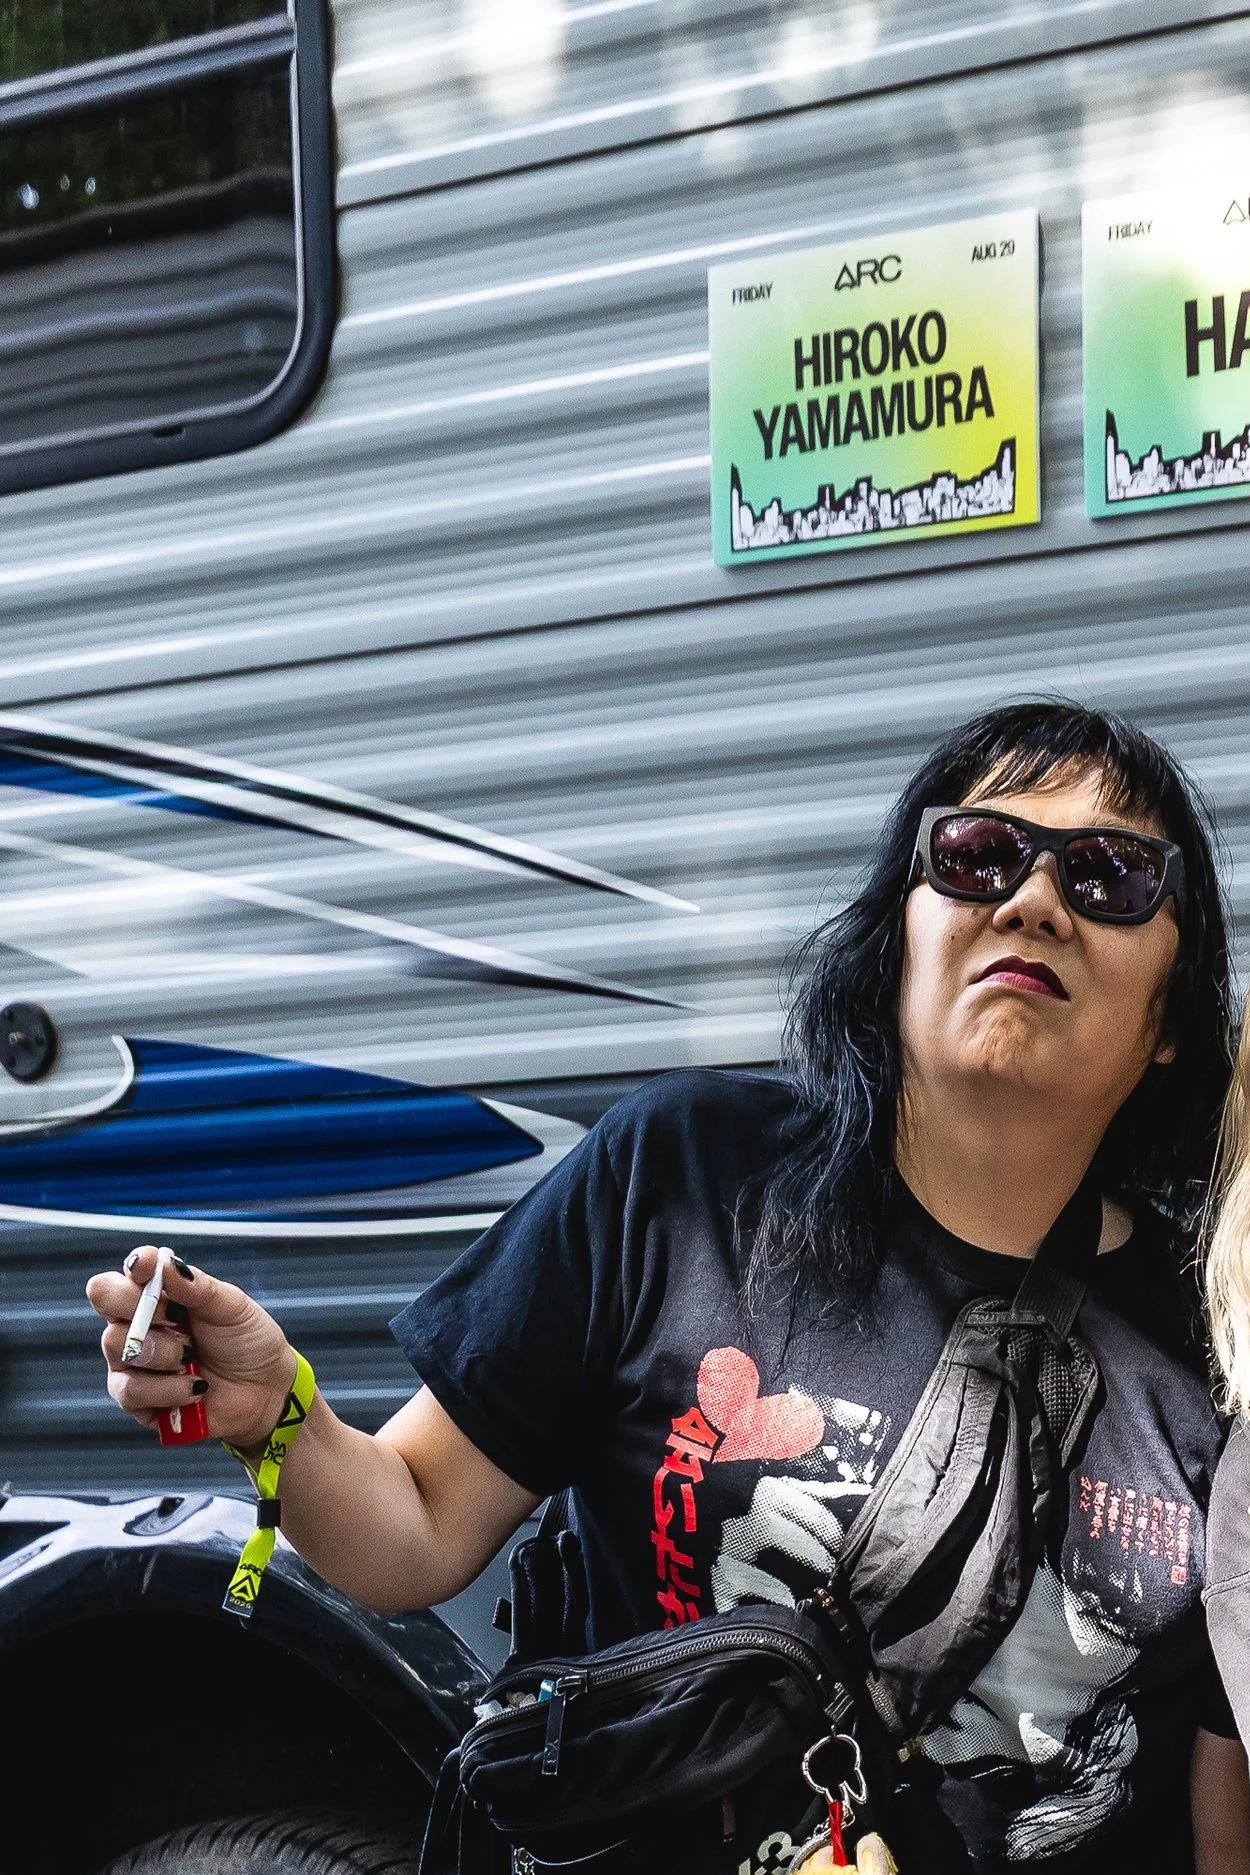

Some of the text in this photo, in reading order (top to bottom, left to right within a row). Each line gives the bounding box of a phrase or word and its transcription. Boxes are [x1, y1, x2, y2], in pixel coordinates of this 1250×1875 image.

[1107, 219, 1153, 242] FRIDAY
[970, 239, 1016, 265] AUG 29
[834, 254, 903, 292] ARC
[731, 282, 774, 306] FRIDAY
[793, 309, 948, 392] HIROKO
[752, 365, 995, 461] YAMAMURA
